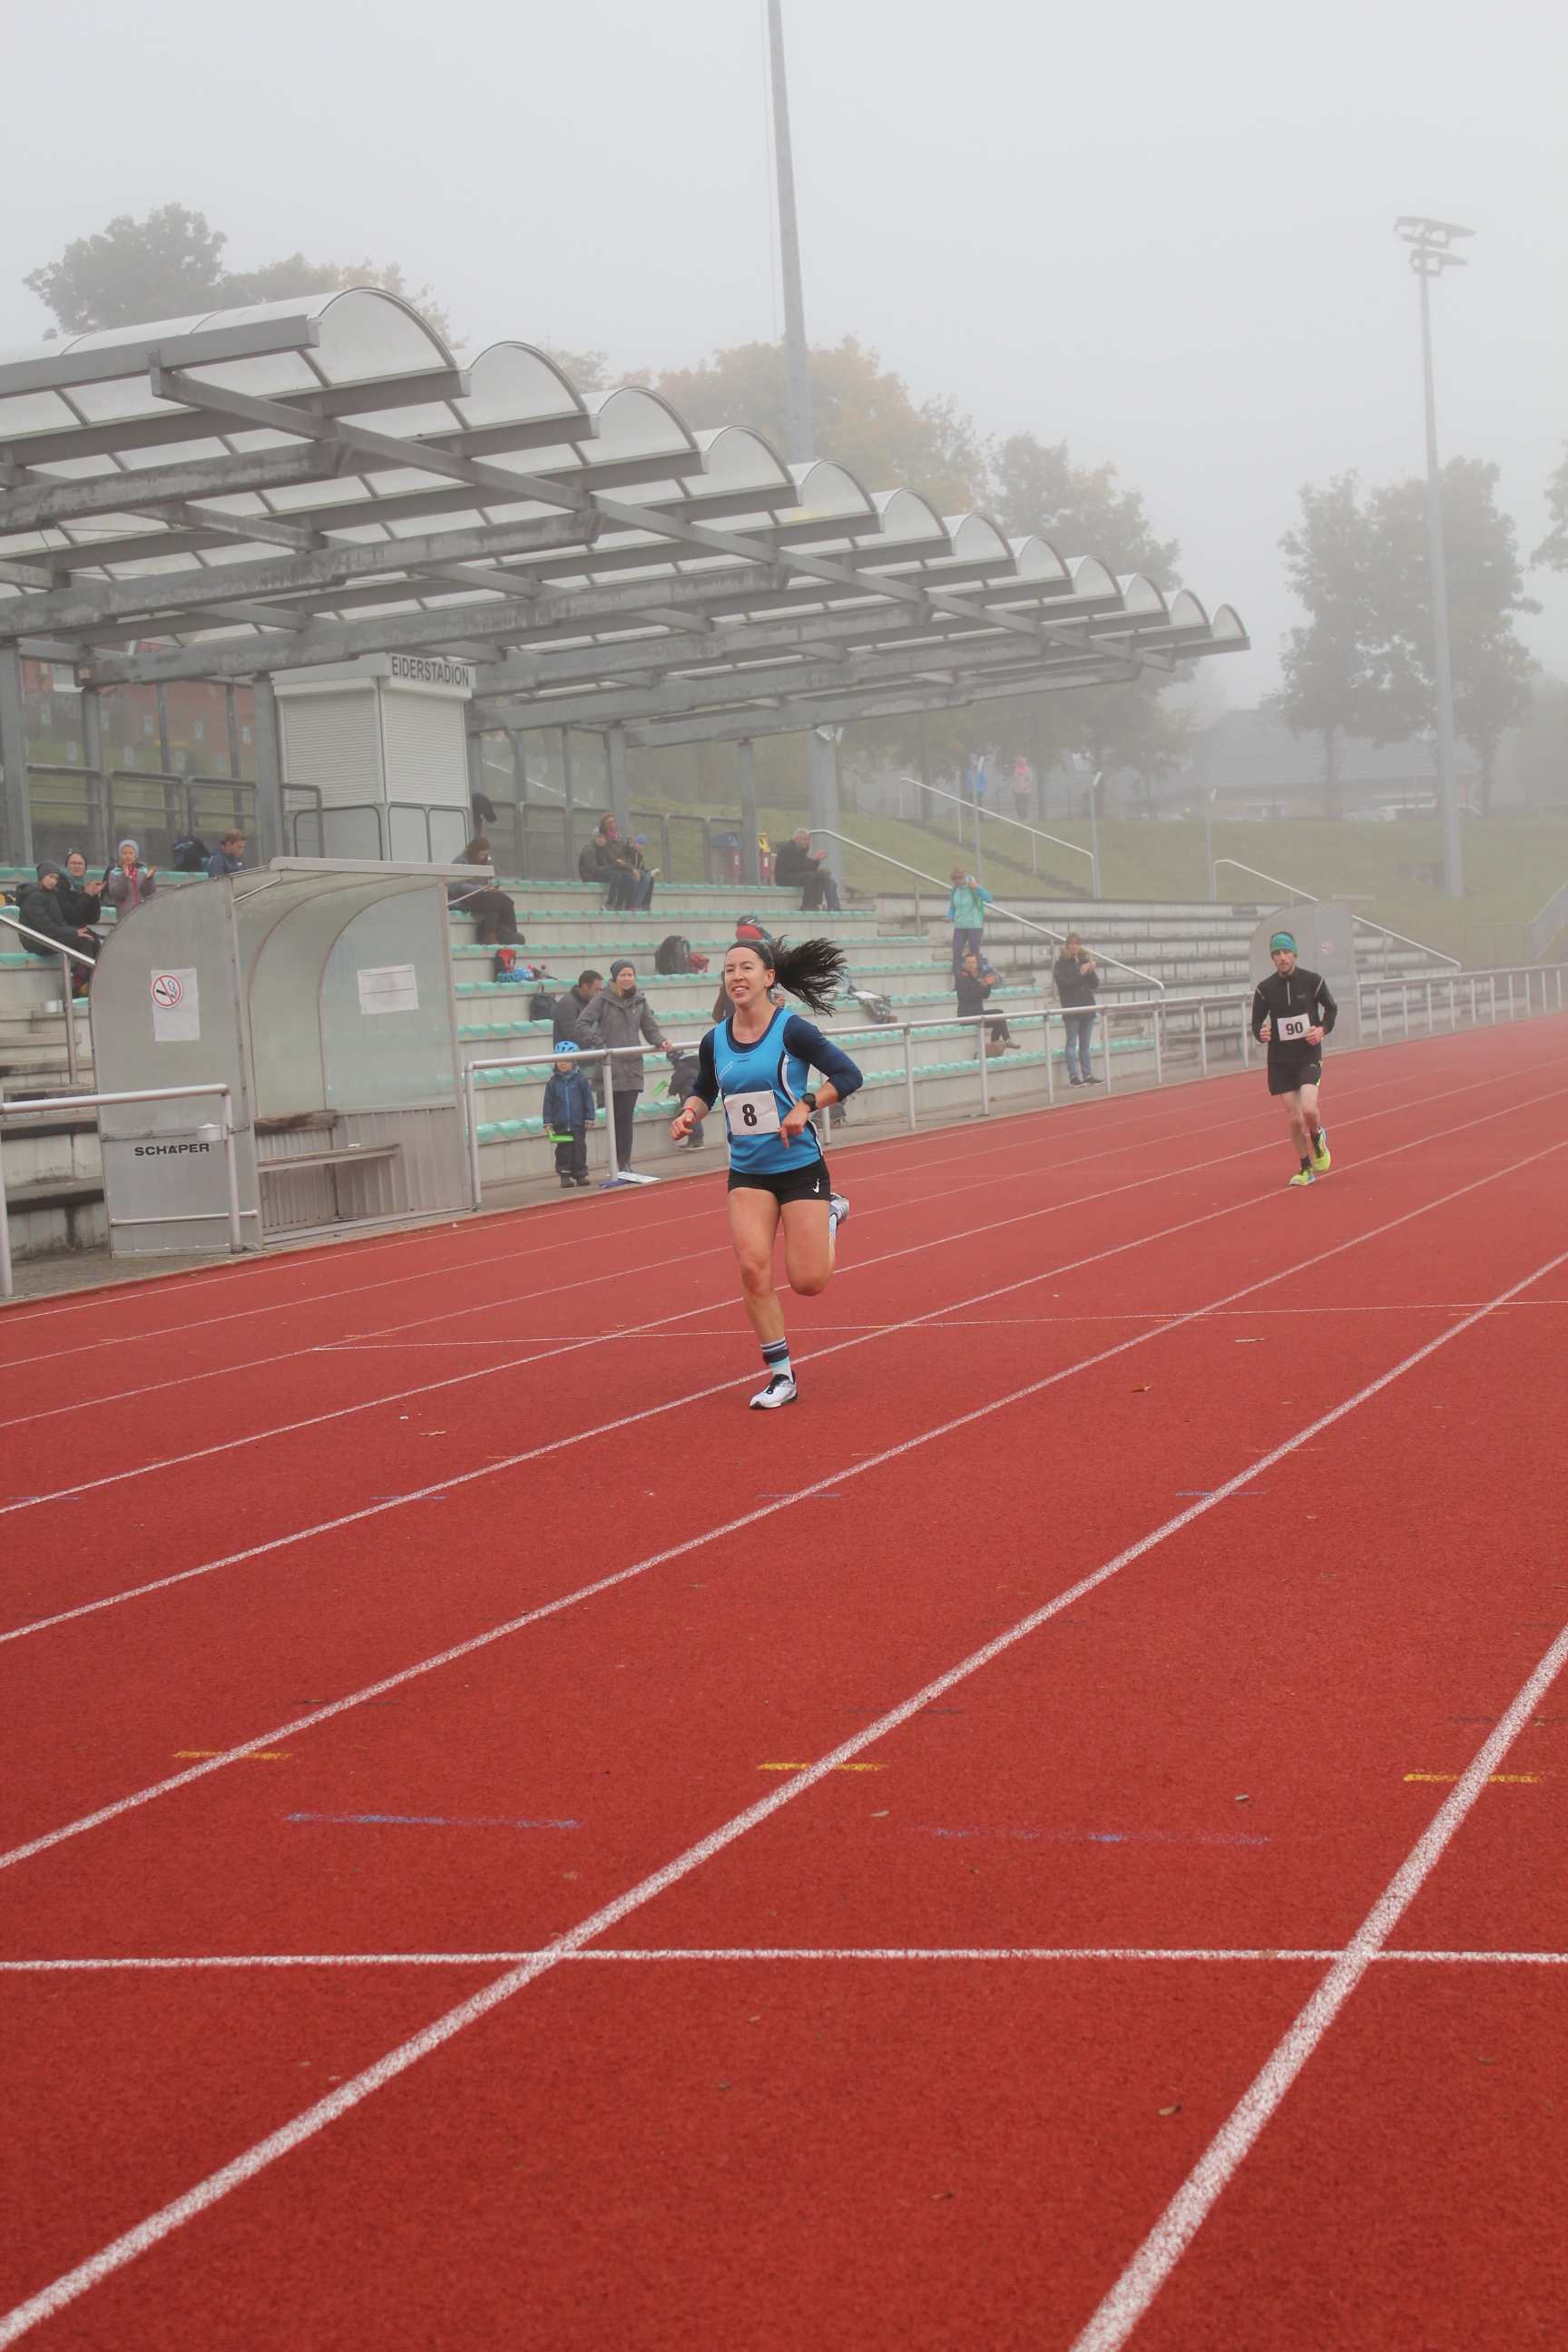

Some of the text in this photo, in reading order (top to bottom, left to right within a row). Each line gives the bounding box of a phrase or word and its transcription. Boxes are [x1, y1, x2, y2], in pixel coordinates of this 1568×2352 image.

[391, 655, 469, 686] EIDERSTADION
[1285, 1022, 1303, 1035] 90
[741, 1103, 758, 1126] 8
